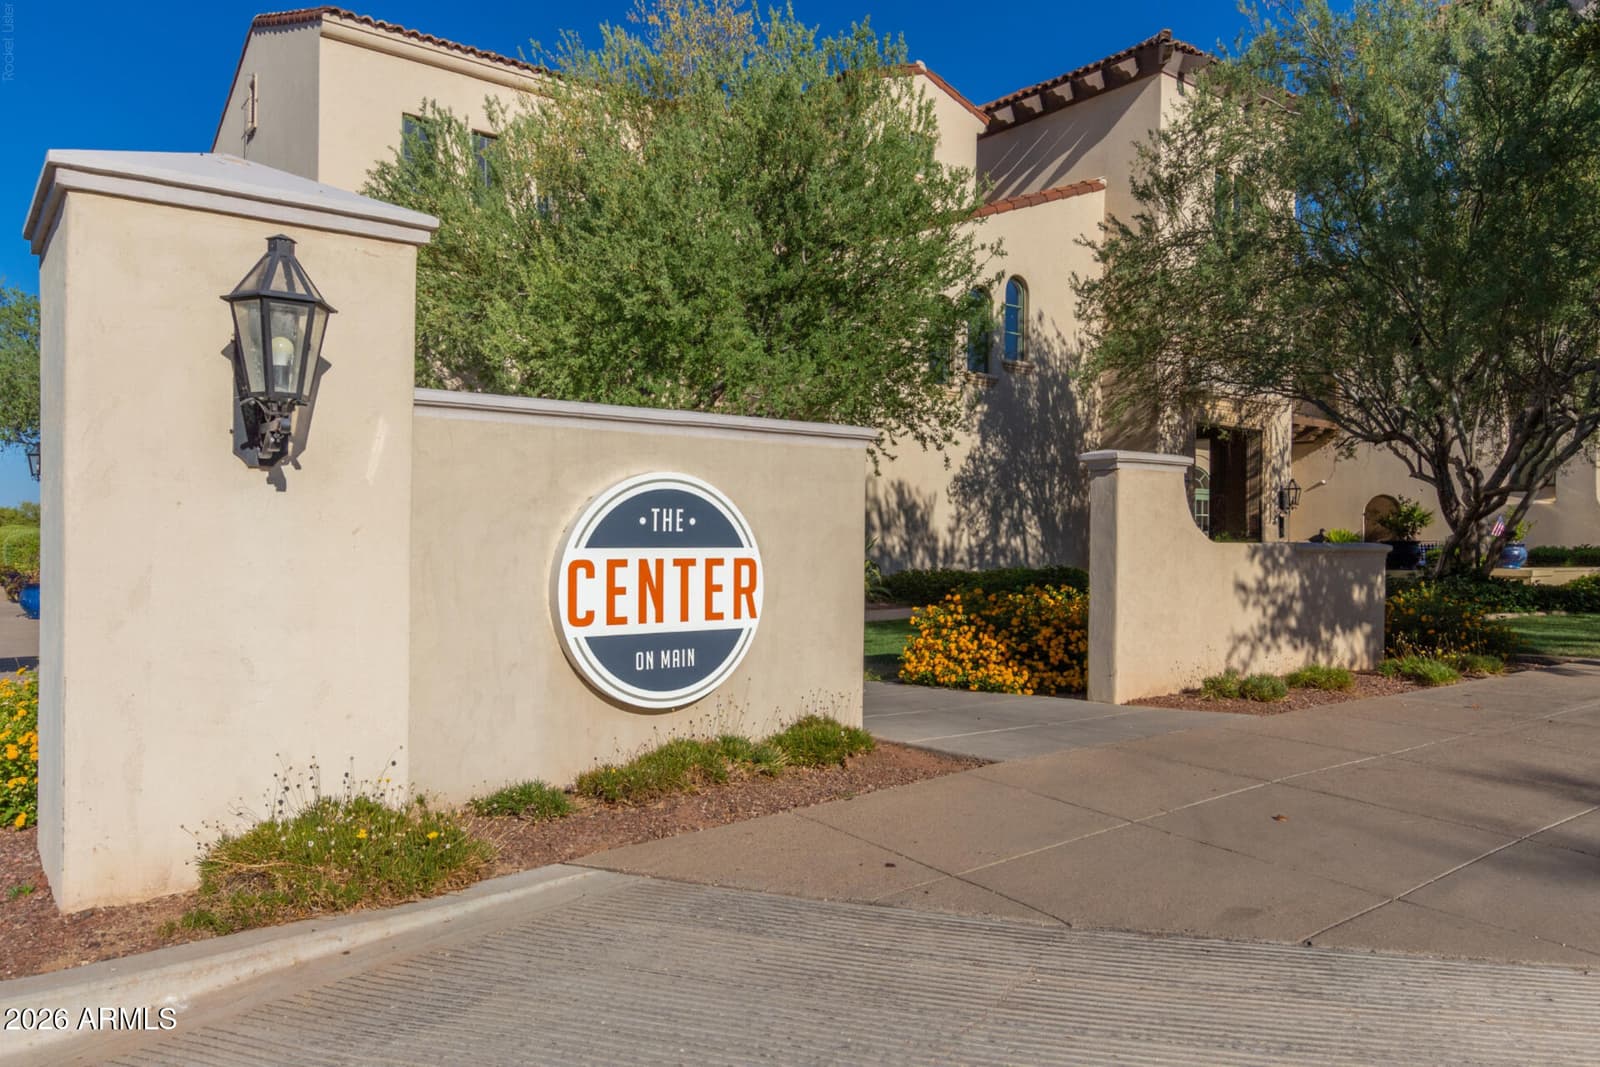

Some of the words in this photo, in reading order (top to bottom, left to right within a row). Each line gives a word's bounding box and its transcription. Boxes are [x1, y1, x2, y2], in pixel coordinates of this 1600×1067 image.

[651, 508, 684, 532] THE
[567, 557, 758, 628] CENTER
[635, 650, 654, 670] ON
[661, 648, 695, 669] MAIN
